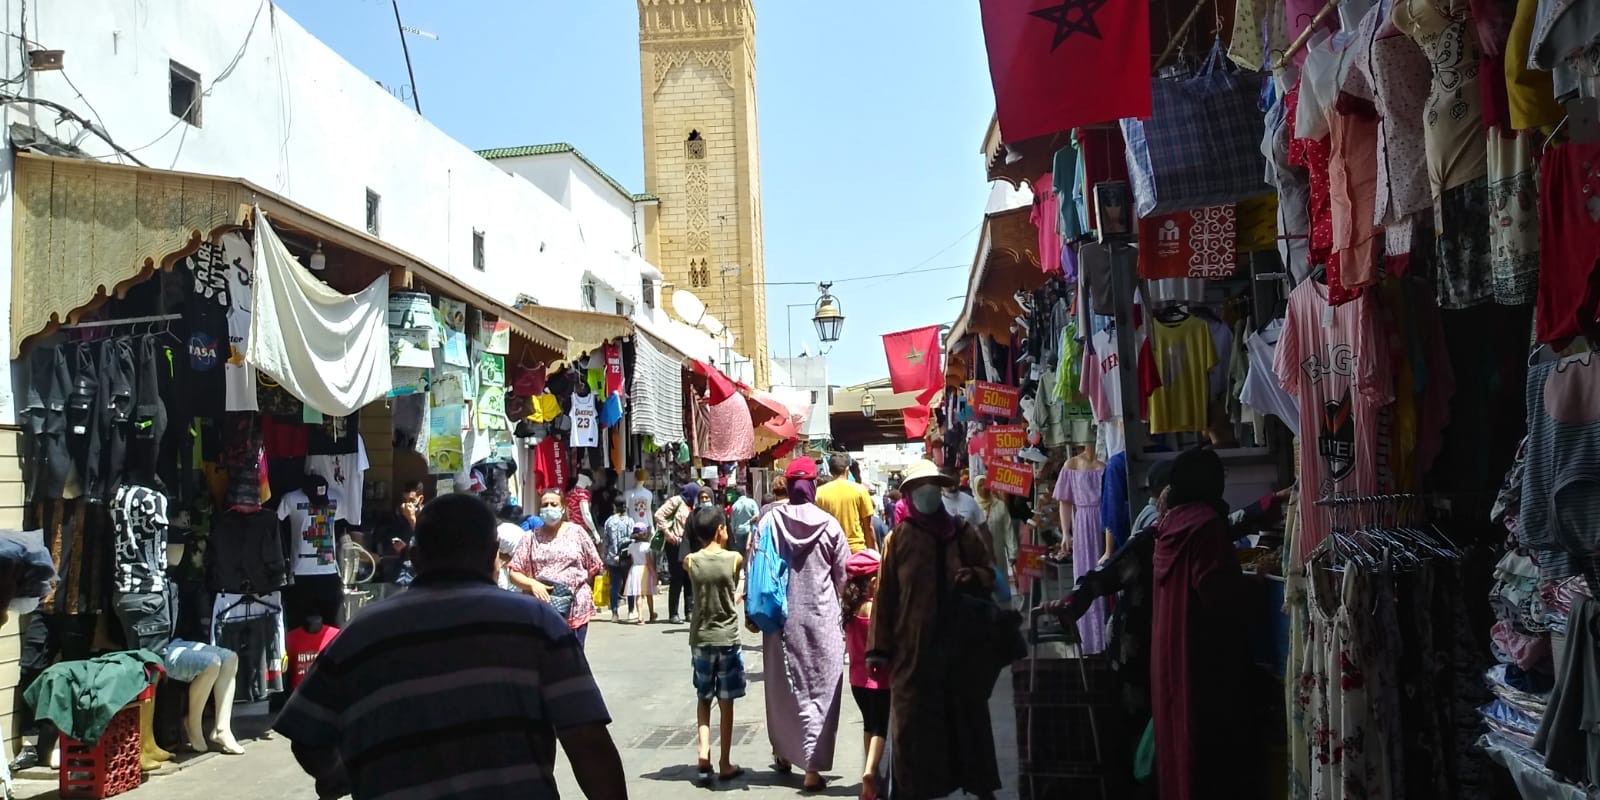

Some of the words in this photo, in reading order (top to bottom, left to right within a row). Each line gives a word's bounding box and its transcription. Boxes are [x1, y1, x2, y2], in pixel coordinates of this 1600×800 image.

[978, 403, 1011, 416] PROMOTION
[577, 417, 590, 428] 23
[993, 447, 1018, 456] PROMOT
[990, 480, 1024, 495] PROMOTION
